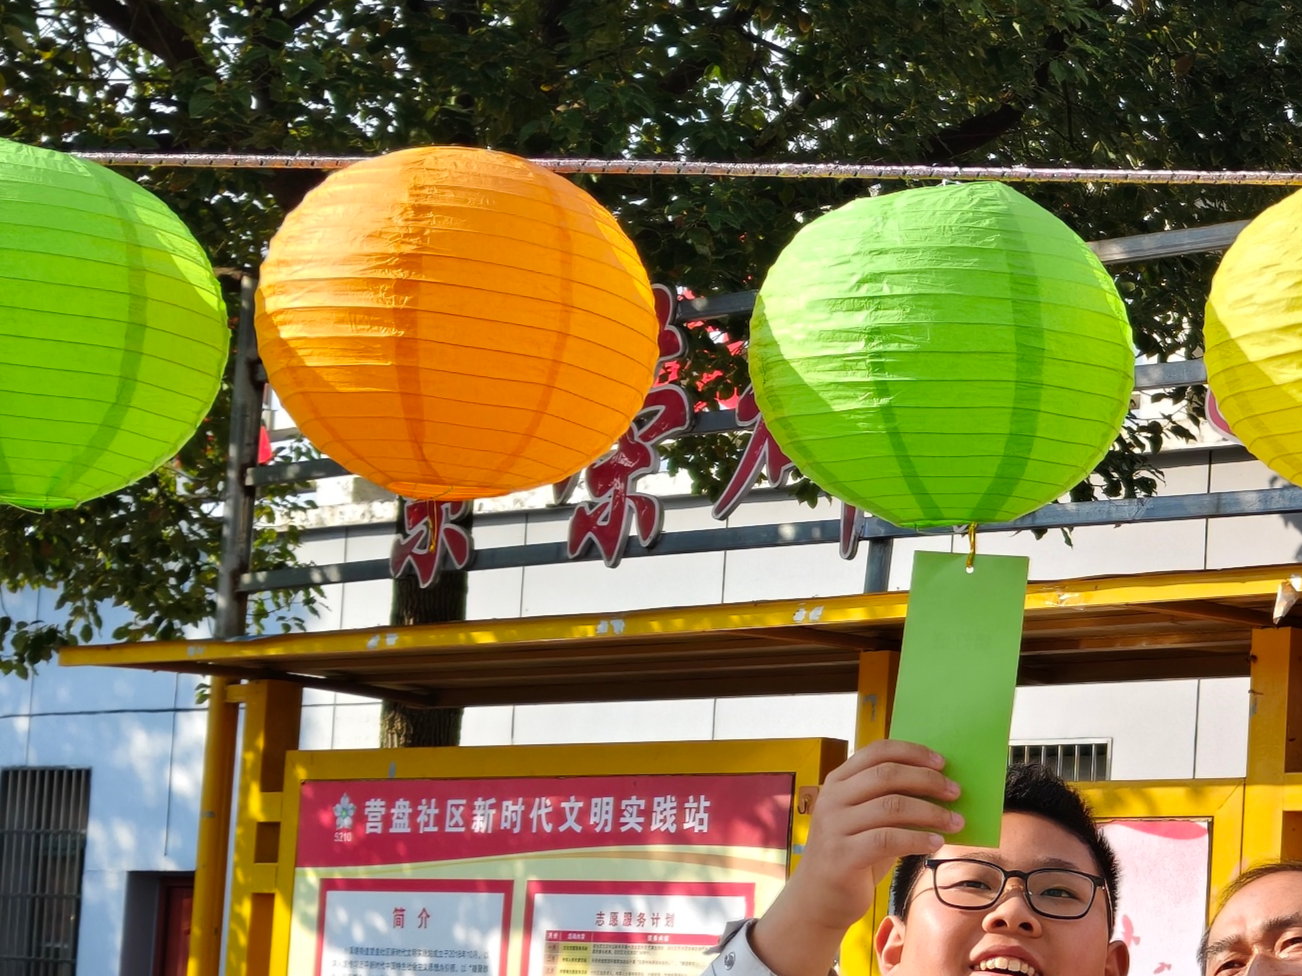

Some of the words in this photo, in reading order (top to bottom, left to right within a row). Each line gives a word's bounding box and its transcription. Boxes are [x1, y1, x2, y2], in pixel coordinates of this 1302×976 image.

[364, 795, 712, 835] 营盘社区新时代文明实践站
[392, 906, 432, 930] 简介
[595, 910, 676, 928] 志愿服务计划
